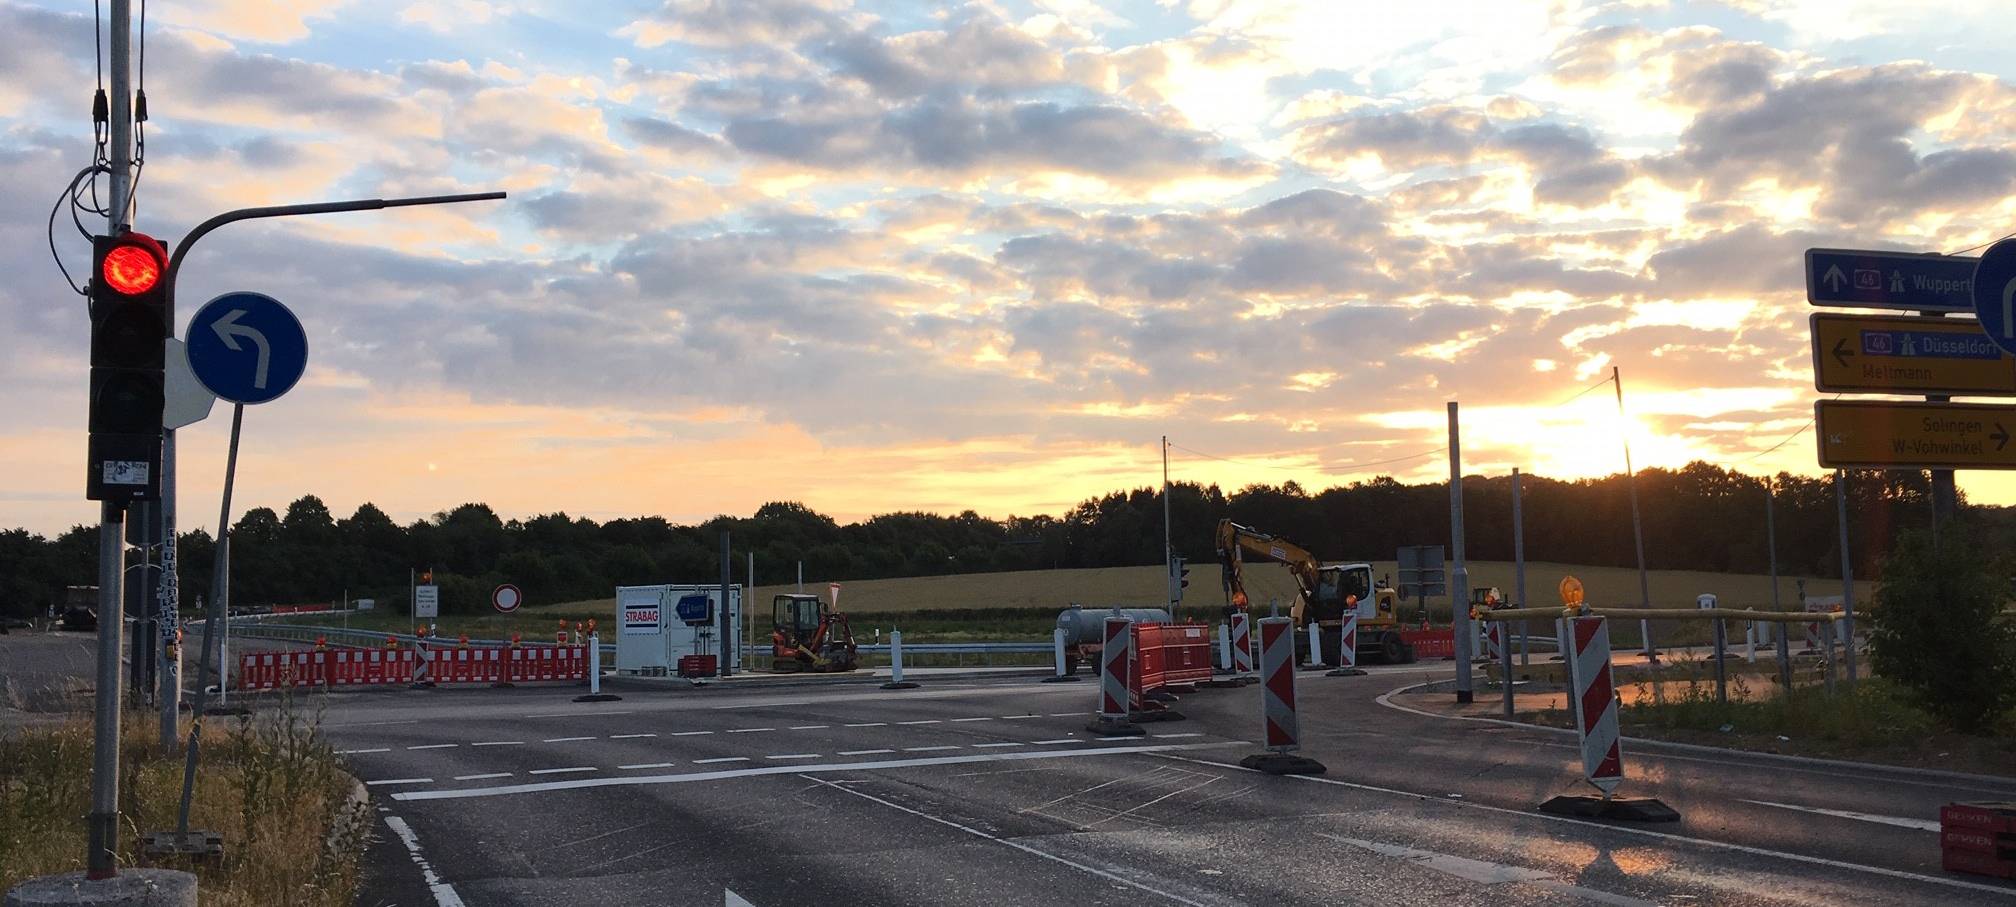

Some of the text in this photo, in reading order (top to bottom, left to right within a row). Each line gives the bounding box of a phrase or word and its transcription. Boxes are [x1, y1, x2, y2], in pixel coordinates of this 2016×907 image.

[1912, 273, 1971, 294] Wuppert
[1871, 335, 1998, 355] 46 Düsseldorf
[1863, 364, 1933, 380] Mettmann
[1923, 417, 1982, 436] Solingen
[1893, 439, 1984, 455] W-Vohwinkel
[625, 611, 658, 622] STRABAG
